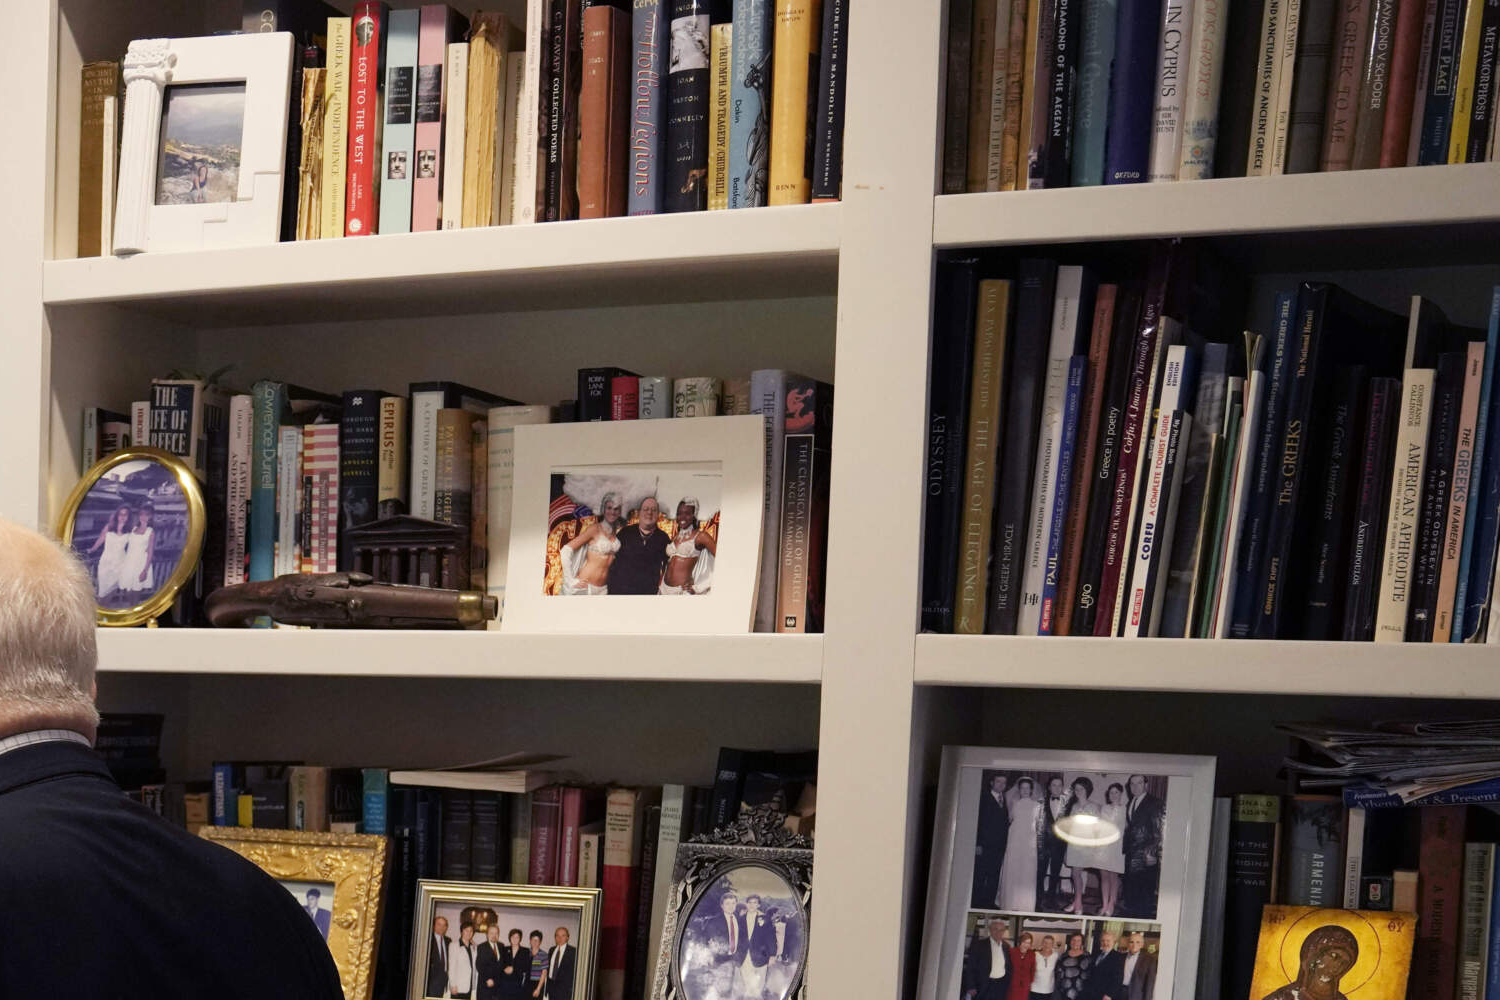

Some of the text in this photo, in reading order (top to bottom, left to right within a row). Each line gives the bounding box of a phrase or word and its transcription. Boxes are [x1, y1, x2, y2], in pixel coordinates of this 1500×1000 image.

[553, 33, 563, 73] CAVAFY
[1161, 5, 1182, 97] IN CYPRUS
[1285, 17, 1298, 58] OLYMPIA
[718, 46, 728, 87] TRIUMPH
[1053, 0, 1068, 137] DIAMOND OF THE AEGEAN
[1253, 13, 1278, 170] SANCTUARIES OF ANCIENT GREECE
[1331, 20, 1357, 143] GREEK TO ME
[1437, 56, 1451, 91] PLACE
[1474, 26, 1497, 121] METAMORPHOSIS
[354, 56, 367, 164] LOST TO THE WEST
[551, 77, 560, 131] COLLECTED
[718, 89, 727, 107] AND
[550, 133, 559, 164] POEMS
[717, 109, 727, 150] TRAGEDY
[988, 76, 1005, 181] WORLD LIBRARY
[1282, 299, 1291, 318] THE
[1276, 320, 1289, 357] GREEKS
[1297, 310, 1314, 377] The National Herald
[155, 387, 178, 406] THE
[1166, 361, 1174, 387] ENGLISH
[1172, 361, 1180, 387] EDITION
[383, 402, 395, 447] EPIRUS
[1407, 385, 1418, 427] CALLINICOS
[929, 412, 946, 495] ODYSSEY
[1041, 438, 1053, 493] PHOTOGRAPHS
[1100, 406, 1121, 479] Greece in poetry
[1167, 418, 1181, 465] My Photo Book
[1258, 433, 1273, 493] Independence
[1279, 420, 1301, 506] The GREEKS
[963, 420, 988, 606] THE AGE OF ELEGANCE
[1141, 414, 1170, 560] CORFU A COMPLETE TOURIST GUIDE
[1435, 480, 1446, 517] GREEK
[1446, 428, 1472, 560] THE GREEKS IN AMERICA
[235, 461, 248, 580] LAWRENCE DURRELL
[786, 510, 795, 566] HAMMOND
[793, 444, 808, 603] THE CLASSICAL AGE OF GREECE
[1035, 506, 1047, 540] MODERN
[1393, 443, 1421, 602] AMERICAN APHRODITE
[1416, 470, 1438, 585] THE AMERICAN WEST
[1428, 521, 1442, 570] ODYSSEY
[998, 523, 1015, 609] THE GREEK MIRACLE
[1031, 541, 1042, 568] GREECE
[1427, 576, 1433, 585] IN
[1357, 799, 1399, 809] Athens
[1432, 795, 1445, 804] &
[1450, 791, 1499, 803] Present
[1309, 852, 1325, 906] ARMENIA
